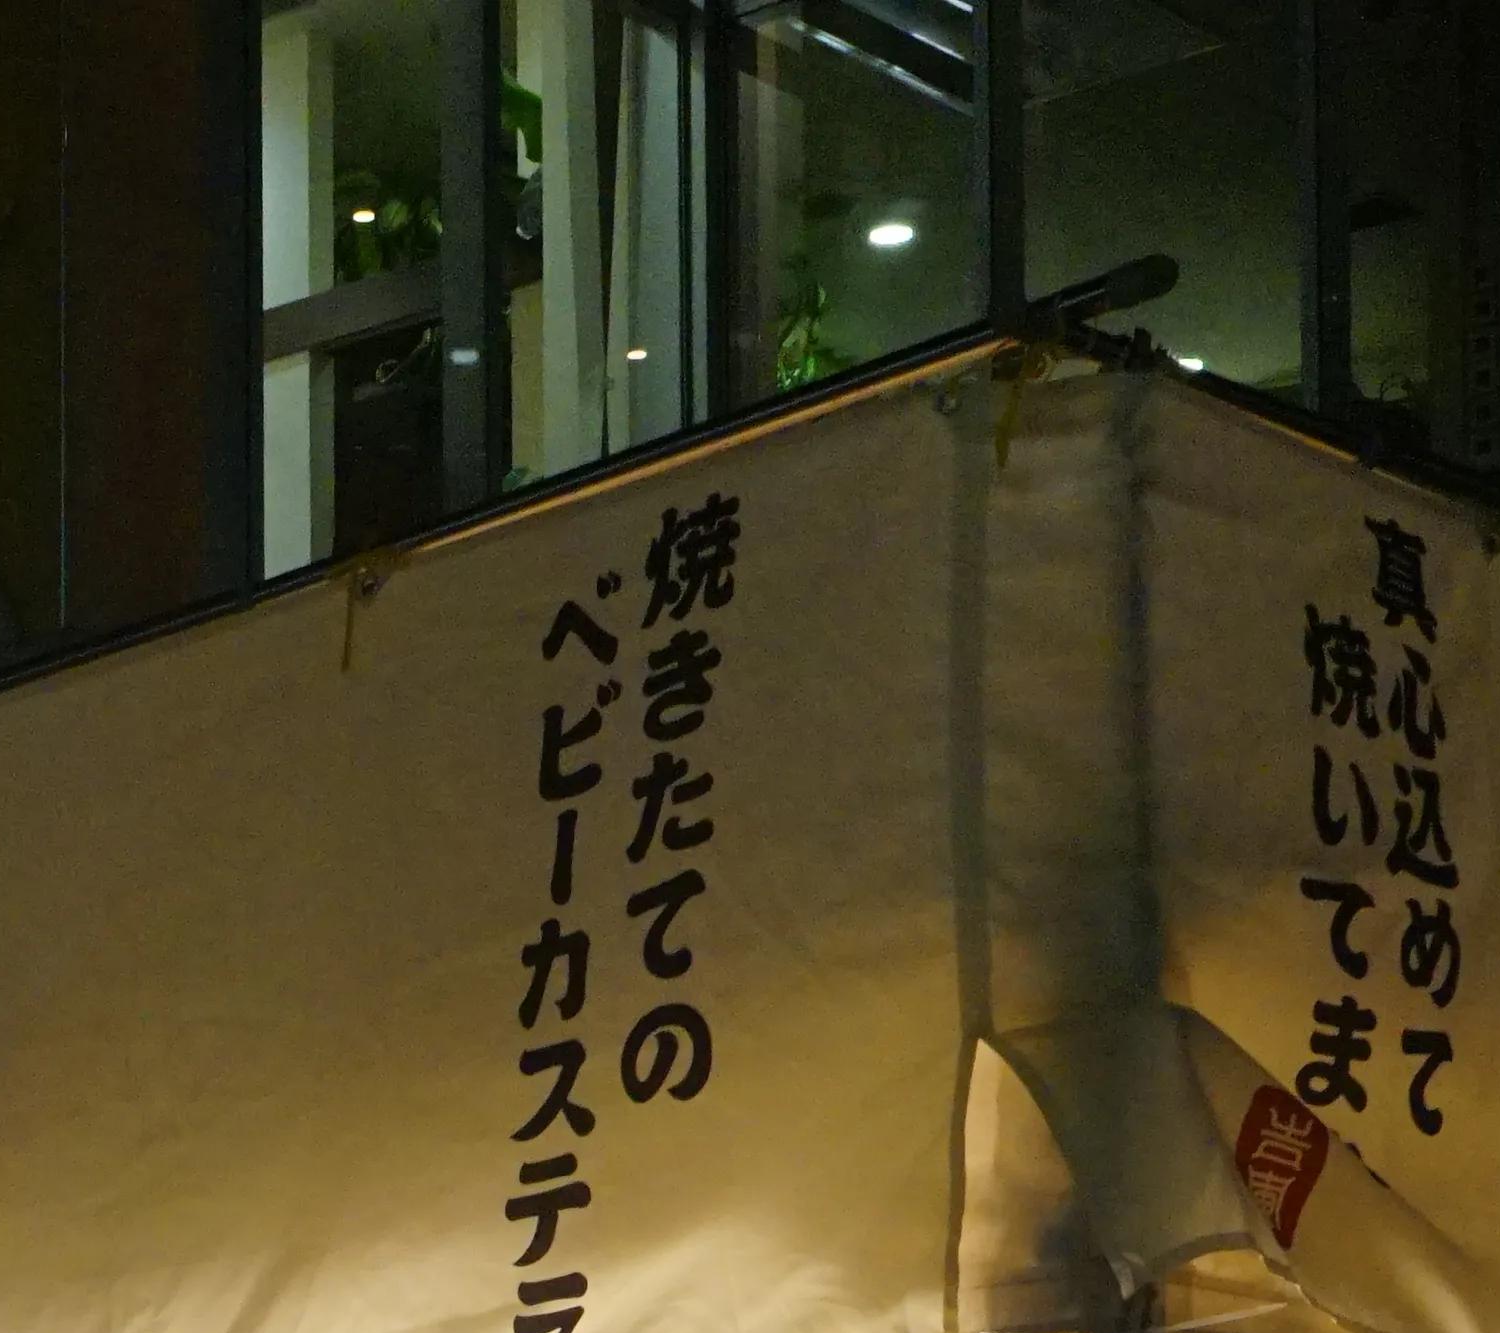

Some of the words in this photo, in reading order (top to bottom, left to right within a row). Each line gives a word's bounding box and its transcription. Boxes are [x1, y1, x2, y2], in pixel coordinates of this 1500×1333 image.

[621, 492, 742, 1103] 焼きたての
[1300, 602, 1382, 1150] 焼いてま
[1362, 515, 1463, 1138] 真心込めて
